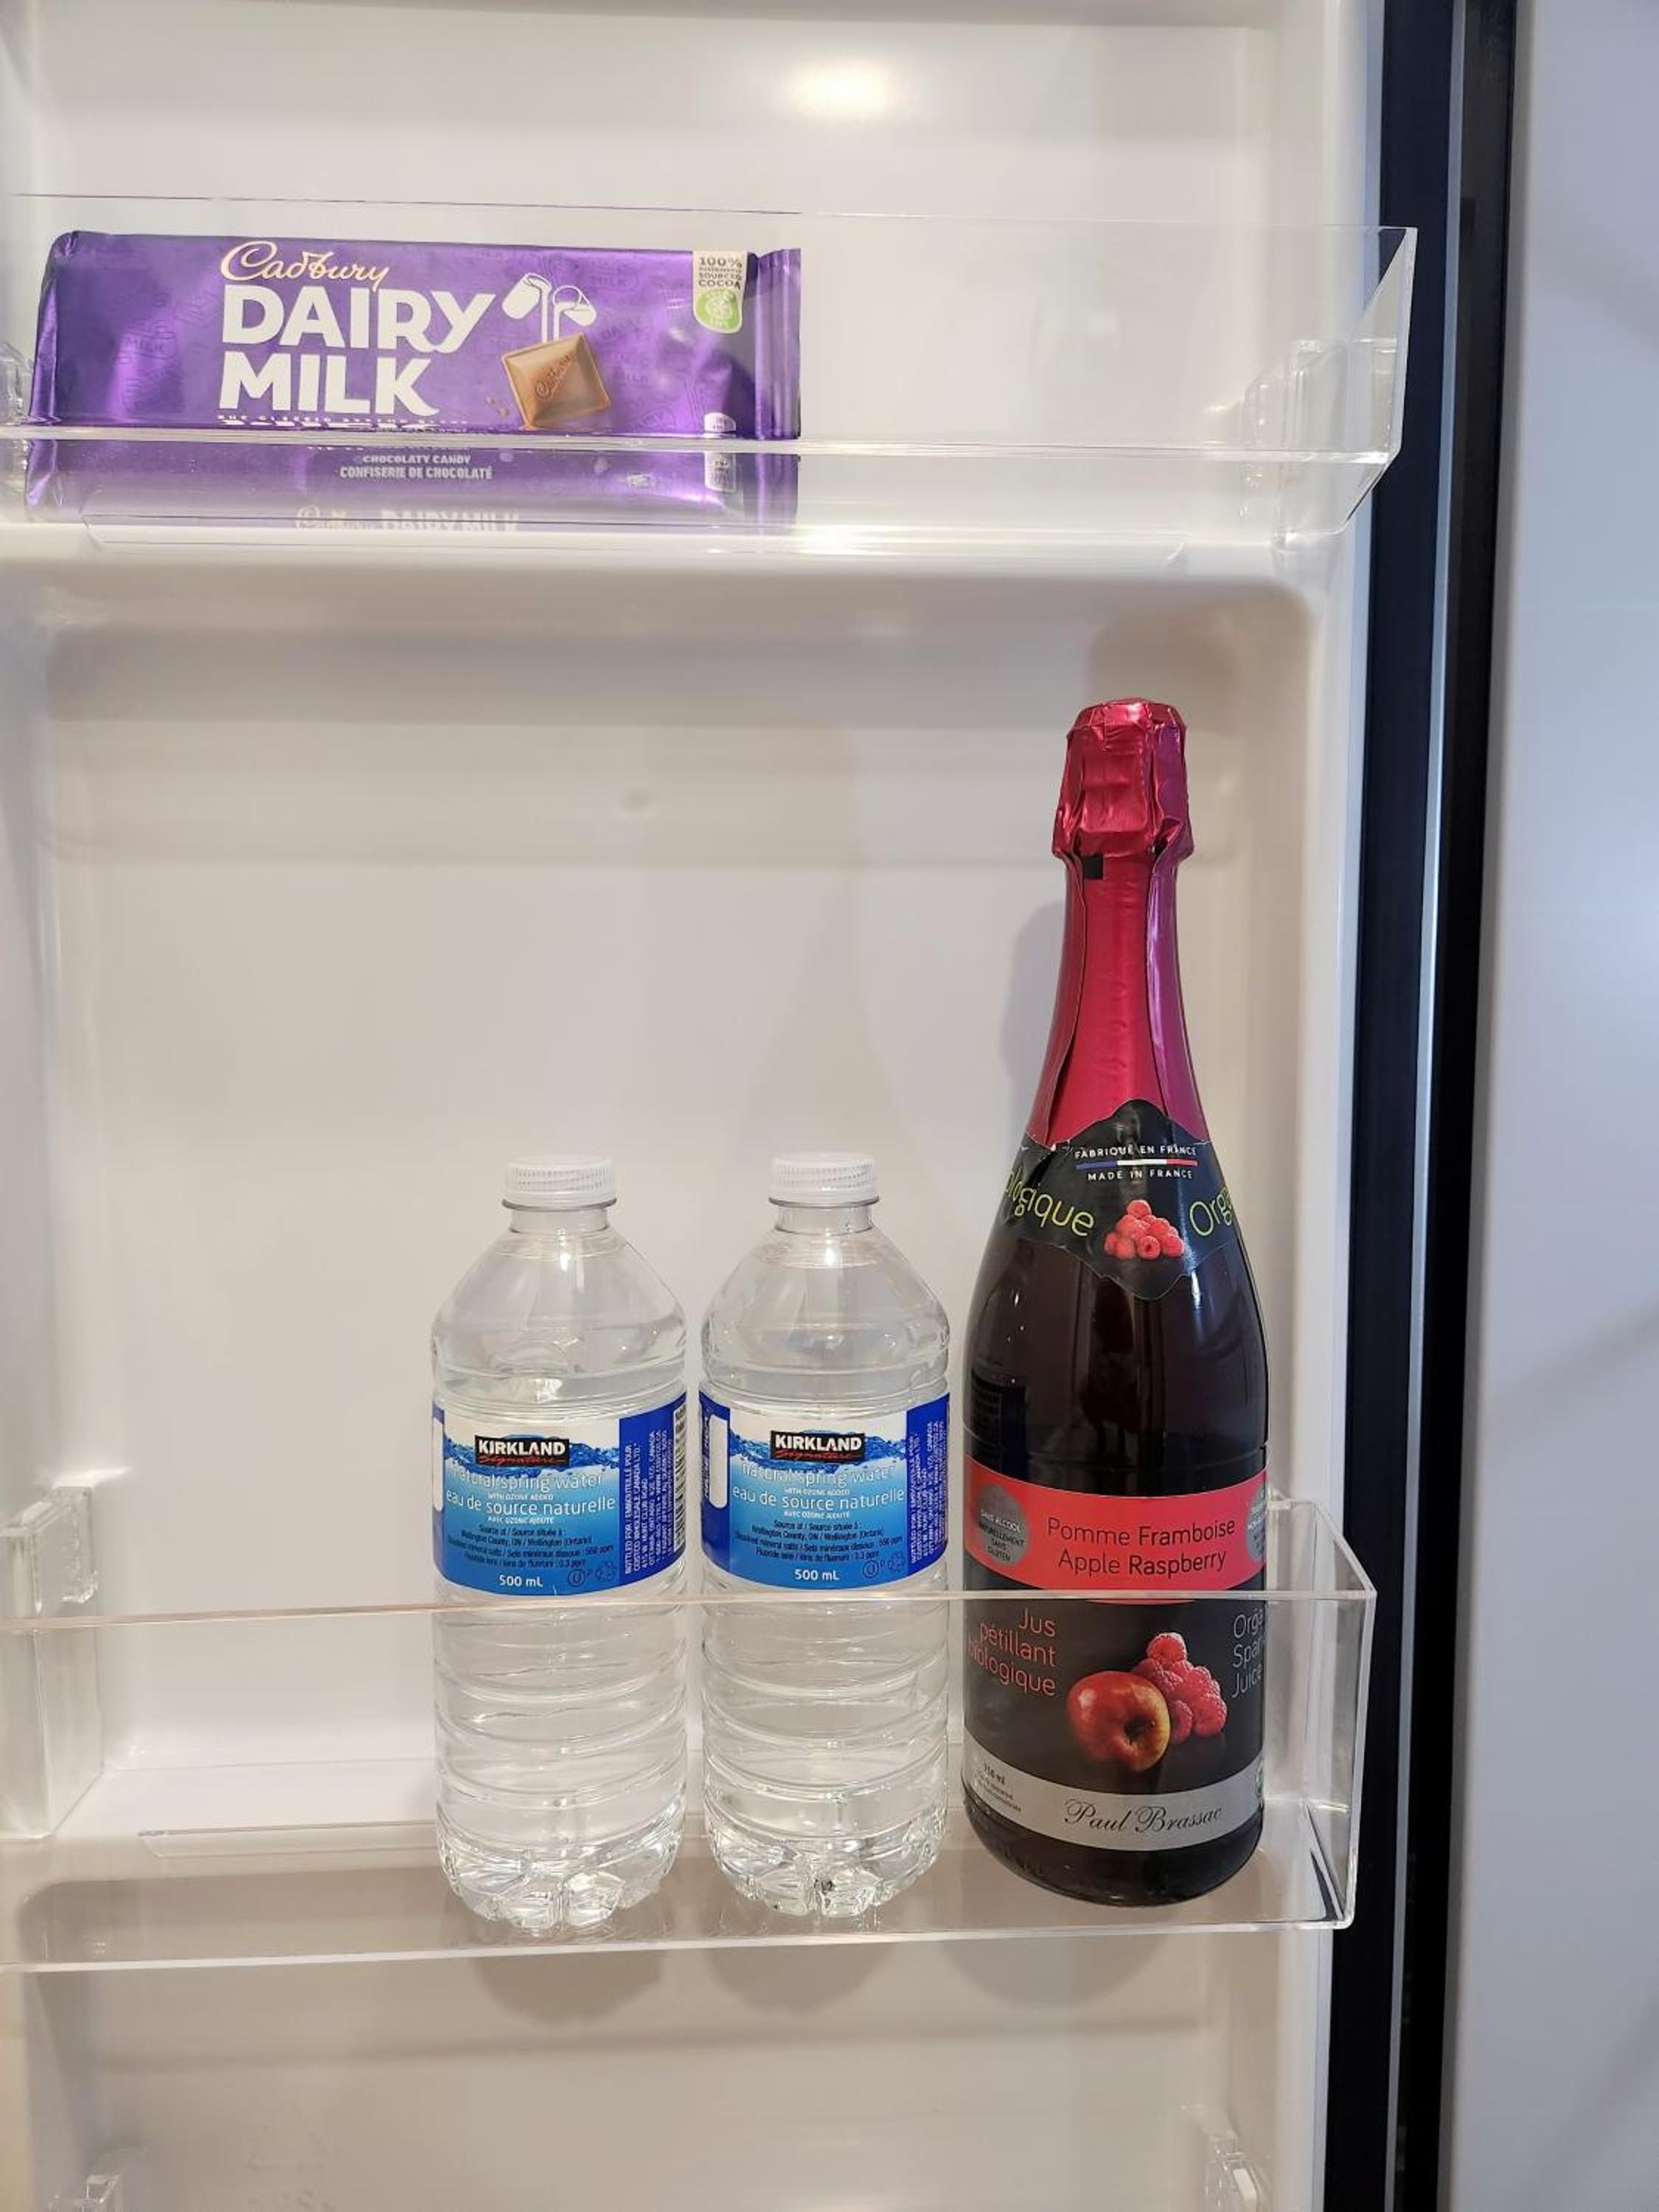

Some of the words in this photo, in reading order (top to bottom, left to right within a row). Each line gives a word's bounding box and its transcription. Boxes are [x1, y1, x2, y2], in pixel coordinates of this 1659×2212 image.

[220, 240, 389, 293] Cadbury
[698, 279, 741, 291] COCOA
[222, 284, 496, 353] DAIRY
[219, 351, 439, 417] MILK
[339, 465, 406, 479] CONFISERIE
[408, 466, 424, 479] DE
[362, 454, 430, 465] CHOCOLATY
[432, 454, 471, 465] CANDY
[1074, 1144, 1135, 1159] FABRIQUE
[1141, 1145, 1155, 1155] EN
[1160, 1145, 1197, 1156] FRANCE
[1088, 1170, 1123, 1180] MADE
[1130, 1170, 1142, 1179] IN
[1150, 1169, 1192, 1179] FRANCE
[478, 1439, 566, 1456] KIRKLAND
[774, 1433, 863, 1452] KIRKLAND
[446, 1489, 465, 1506] eau
[467, 1495, 481, 1510] de
[486, 1501, 538, 1516] source
[543, 1496, 616, 1516] naturelle
[732, 1485, 756, 1503] eau
[759, 1489, 777, 1506] de
[782, 1496, 834, 1511] source
[839, 1487, 905, 1510] naturelle
[1047, 1516, 1130, 1547] Pomme
[1138, 1519, 1236, 1547] Framboise
[794, 1568, 818, 1581] 500
[821, 1569, 840, 1581] mL
[1057, 1548, 1121, 1576] Apple
[1128, 1551, 1227, 1579] Raspberry
[498, 1573, 522, 1587] 500
[525, 1575, 543, 1587] mL
[1018, 1607, 1056, 1638] Jus
[980, 1622, 1056, 1667] pétillant
[967, 1632, 1056, 1696] biologique
[1064, 1798, 1133, 1832] Paul
[1135, 1805, 1223, 1832] Brassac
